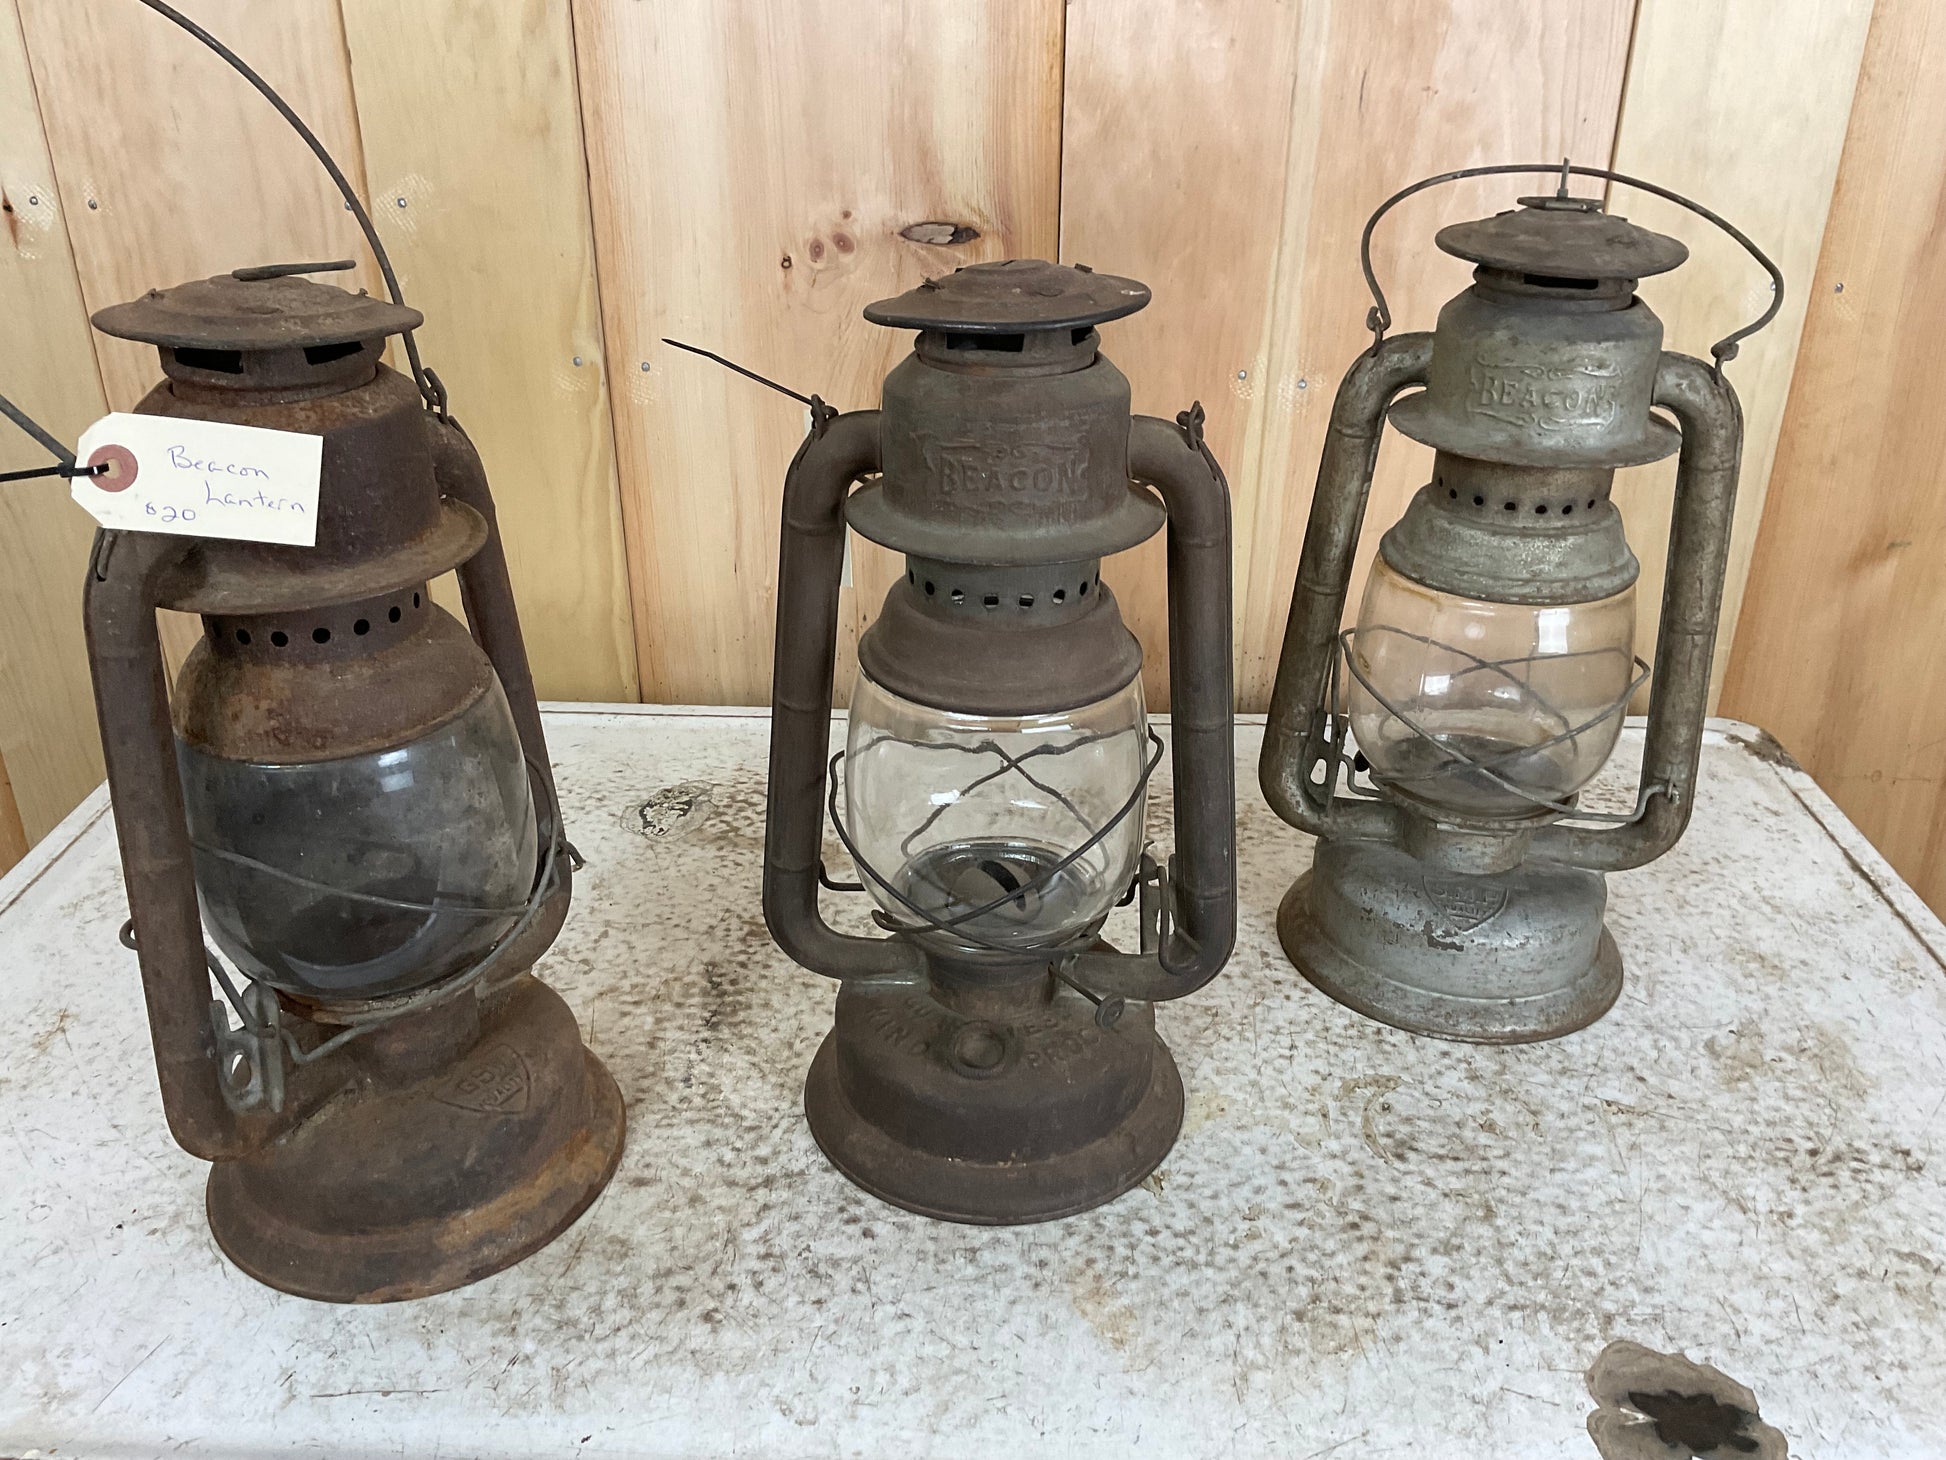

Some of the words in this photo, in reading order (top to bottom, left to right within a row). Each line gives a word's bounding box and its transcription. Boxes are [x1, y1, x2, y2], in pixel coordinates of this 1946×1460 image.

[1480, 374, 1608, 416] BEACON
[166, 445, 271, 479] Beacon
[938, 454, 1078, 494] BEACON
[204, 480, 305, 514] Lantern
